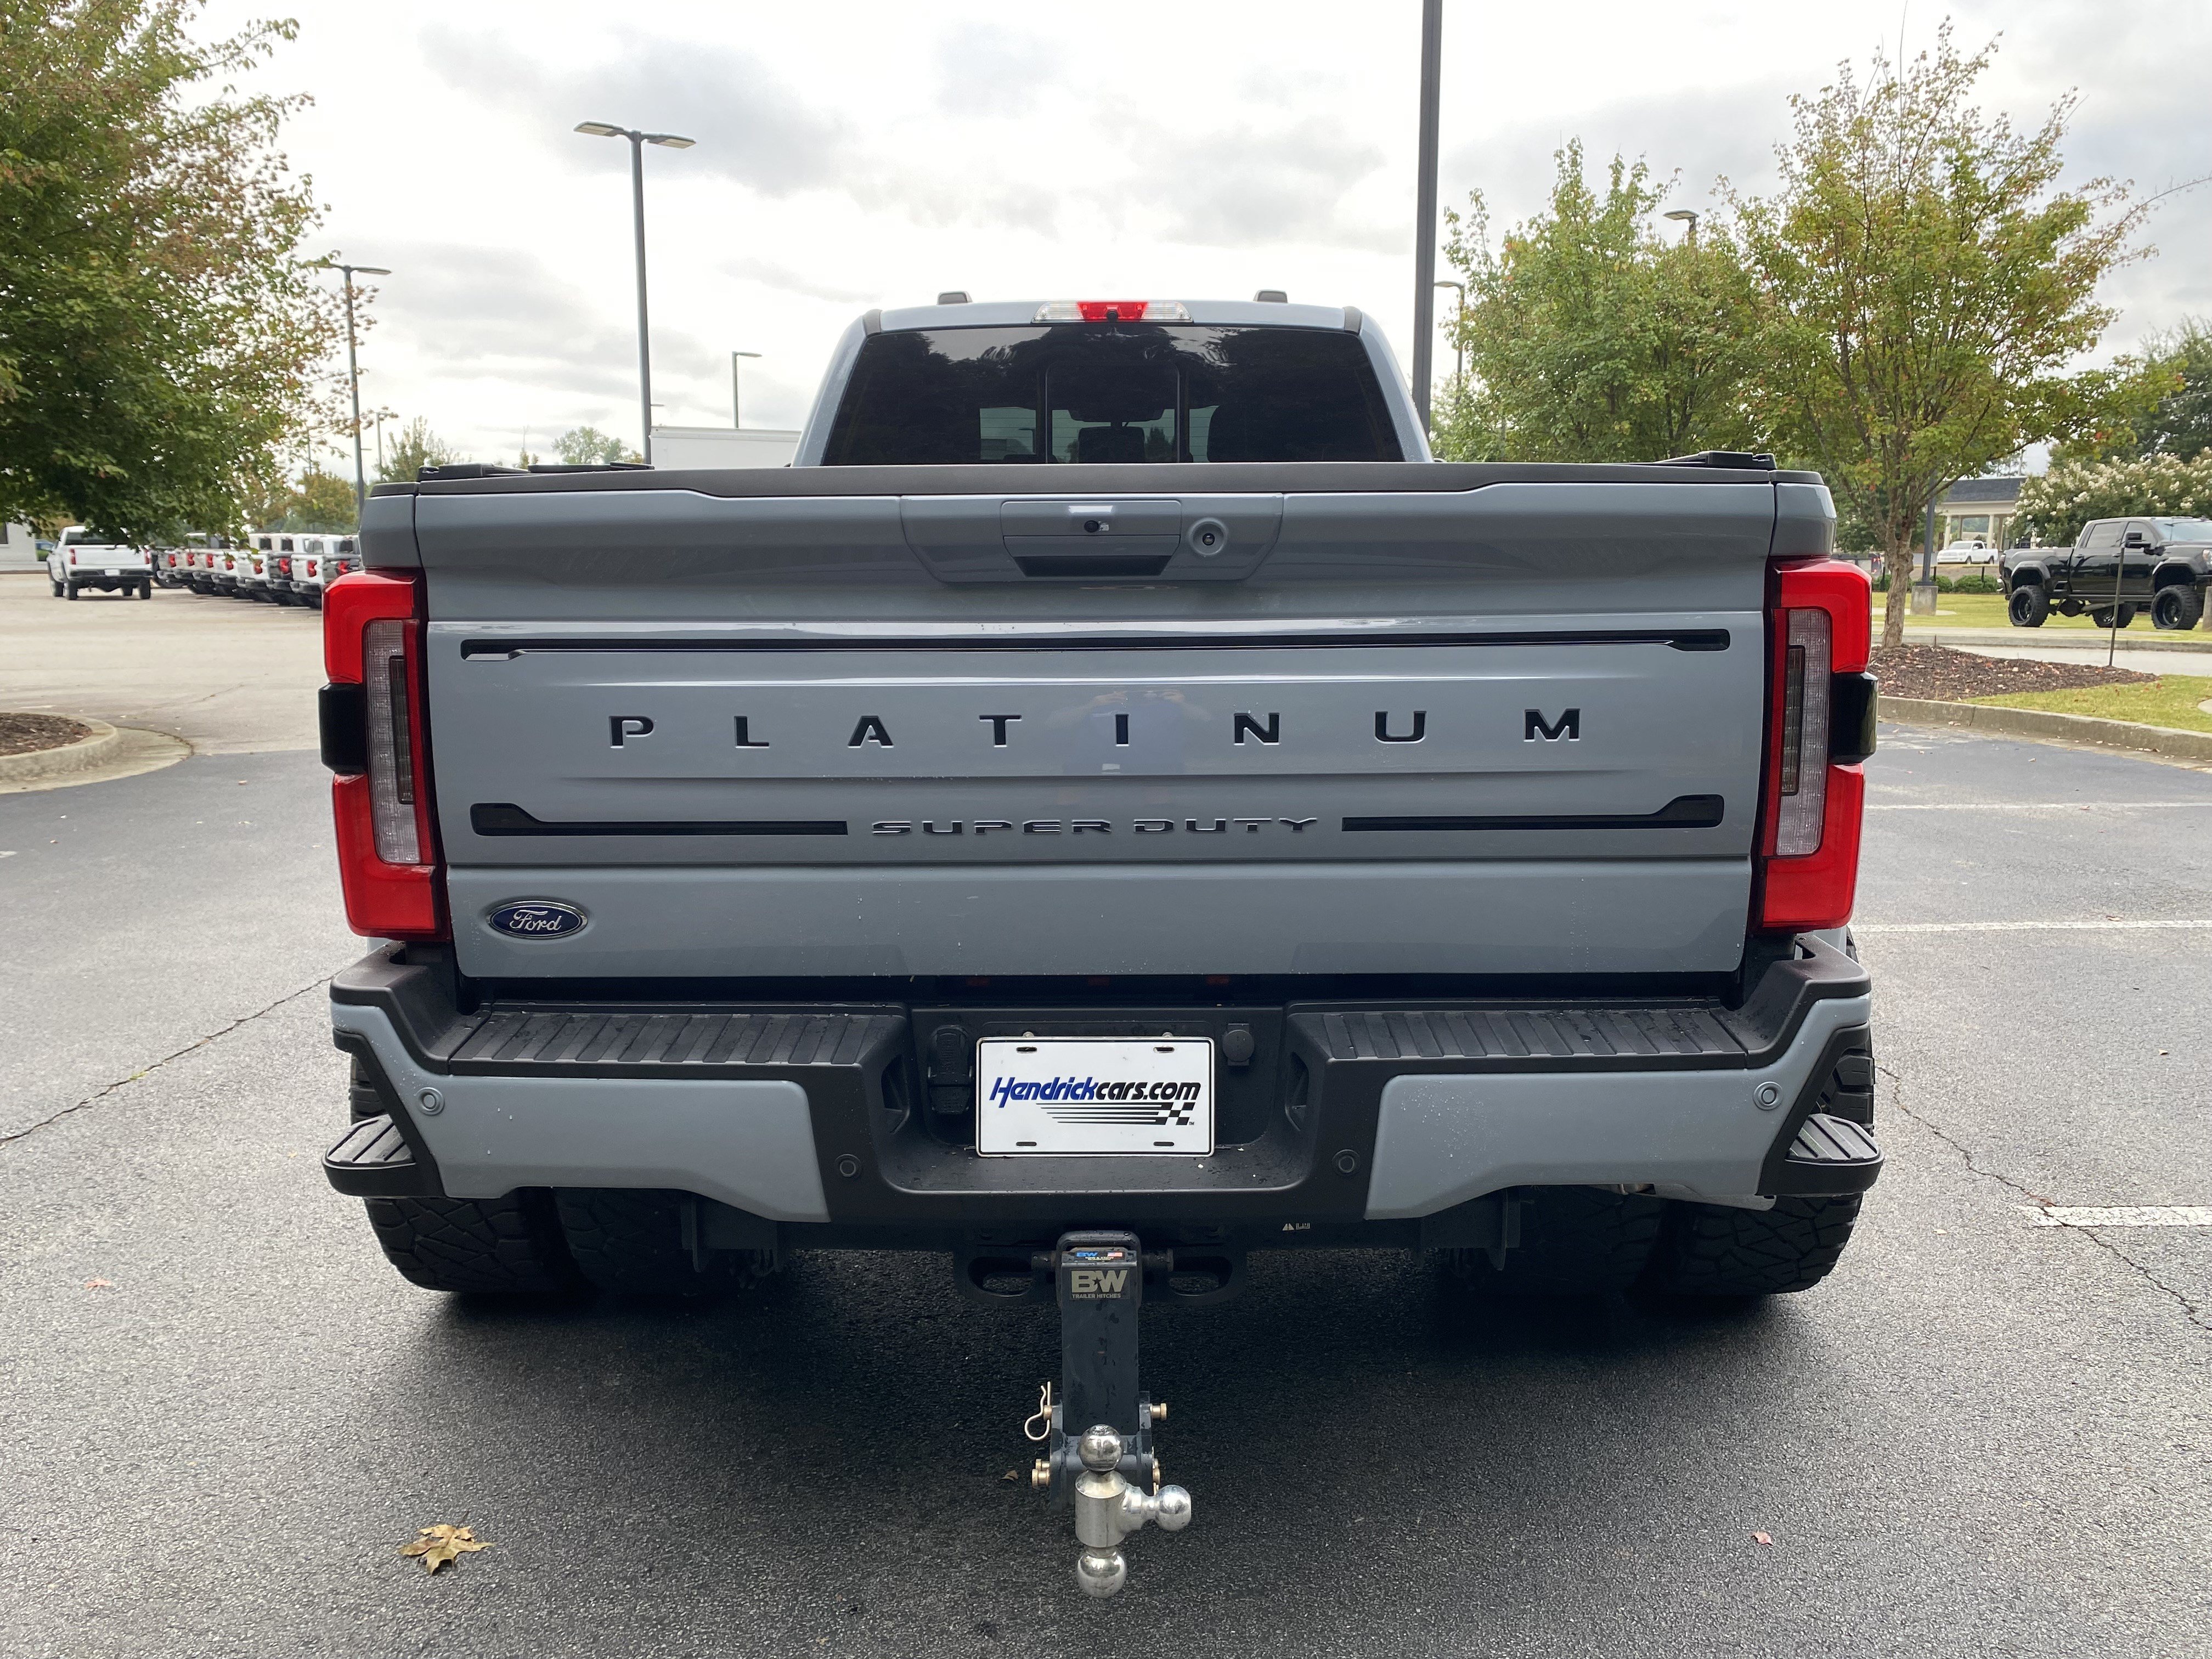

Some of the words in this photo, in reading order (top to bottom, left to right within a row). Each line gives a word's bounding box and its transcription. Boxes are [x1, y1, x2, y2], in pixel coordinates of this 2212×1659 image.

[609, 708, 1581, 749] PLATINUM
[871, 819, 1112, 835] SUPER
[1133, 817, 1318, 833] DUTY
[509, 909, 562, 932] Ford
[989, 1076, 1201, 1109] Hendrickcars.com
